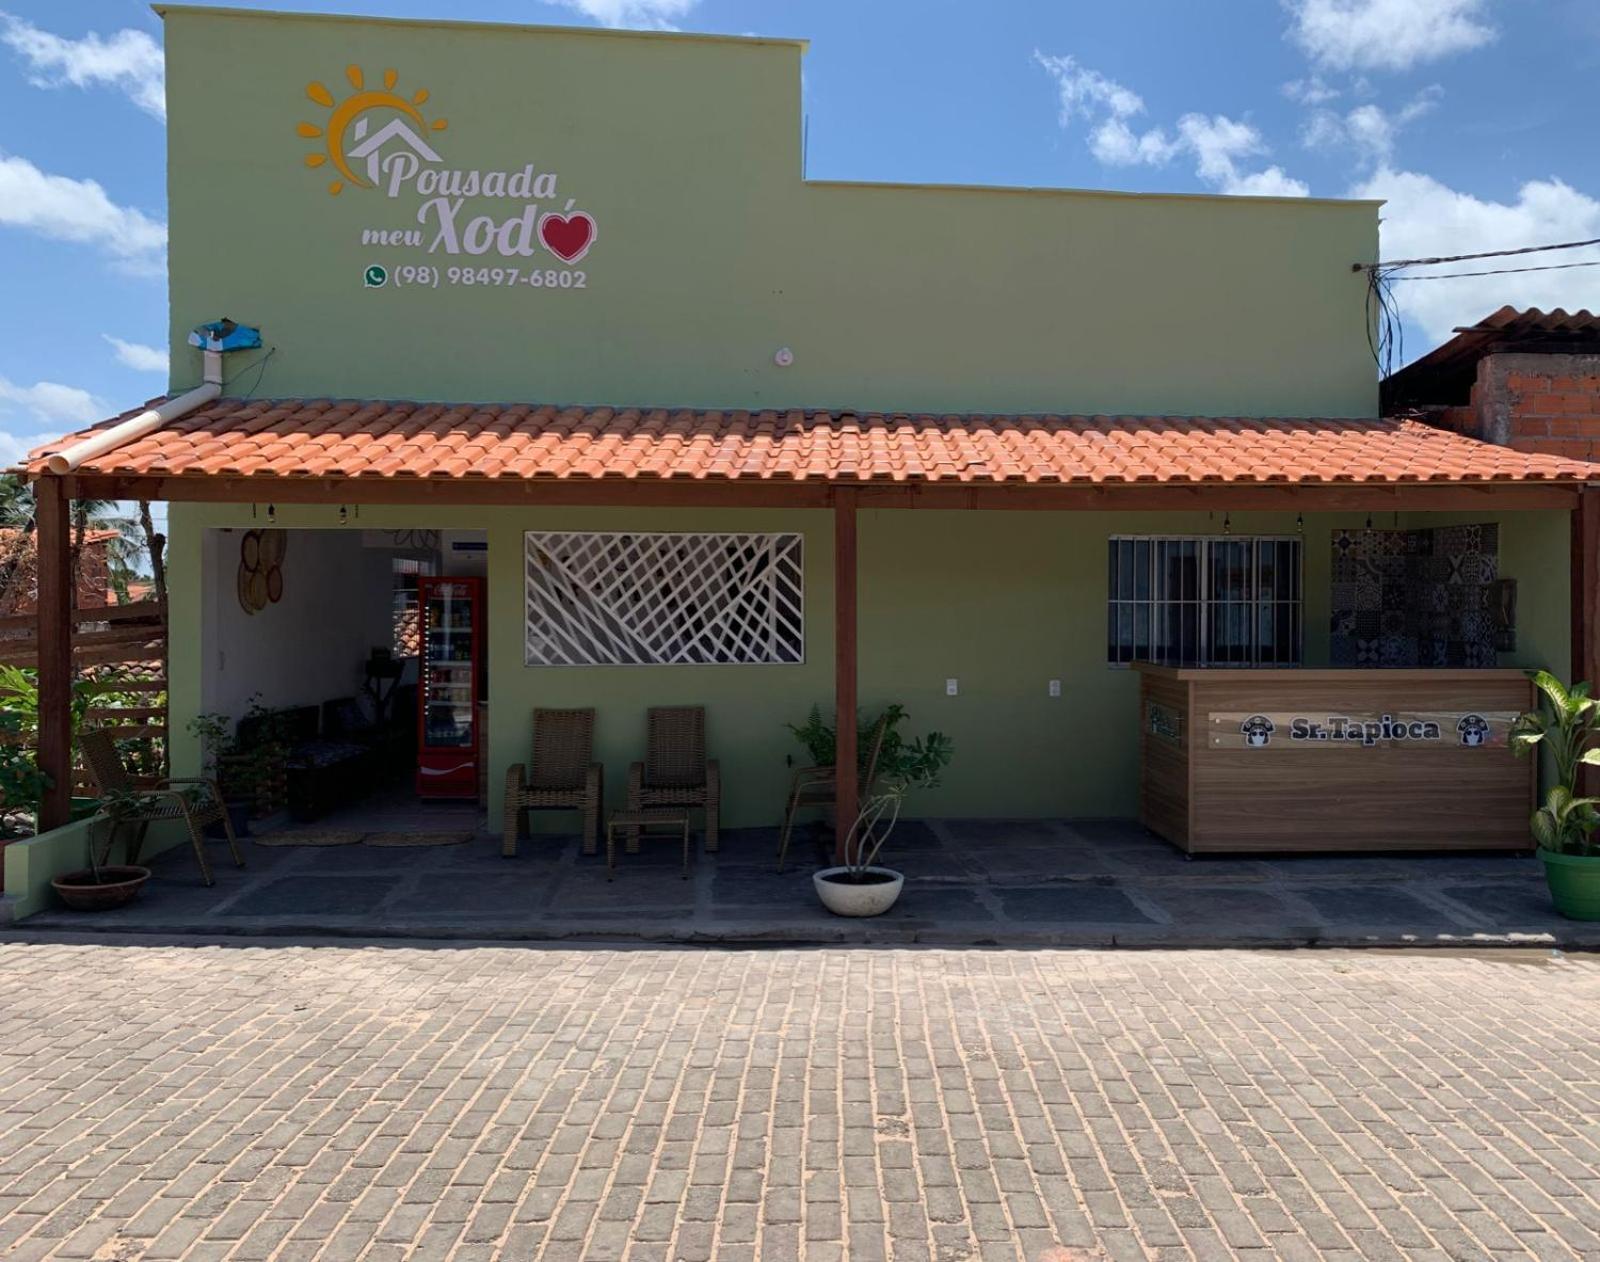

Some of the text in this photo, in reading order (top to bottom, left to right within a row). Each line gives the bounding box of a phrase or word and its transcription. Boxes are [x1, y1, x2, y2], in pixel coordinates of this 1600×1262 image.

[382, 151, 558, 199] Pousada
[361, 228, 423, 247] meu
[394, 265, 587, 288] (98) 98497-6802
[1291, 715, 1440, 746] Sr. Tapioca
